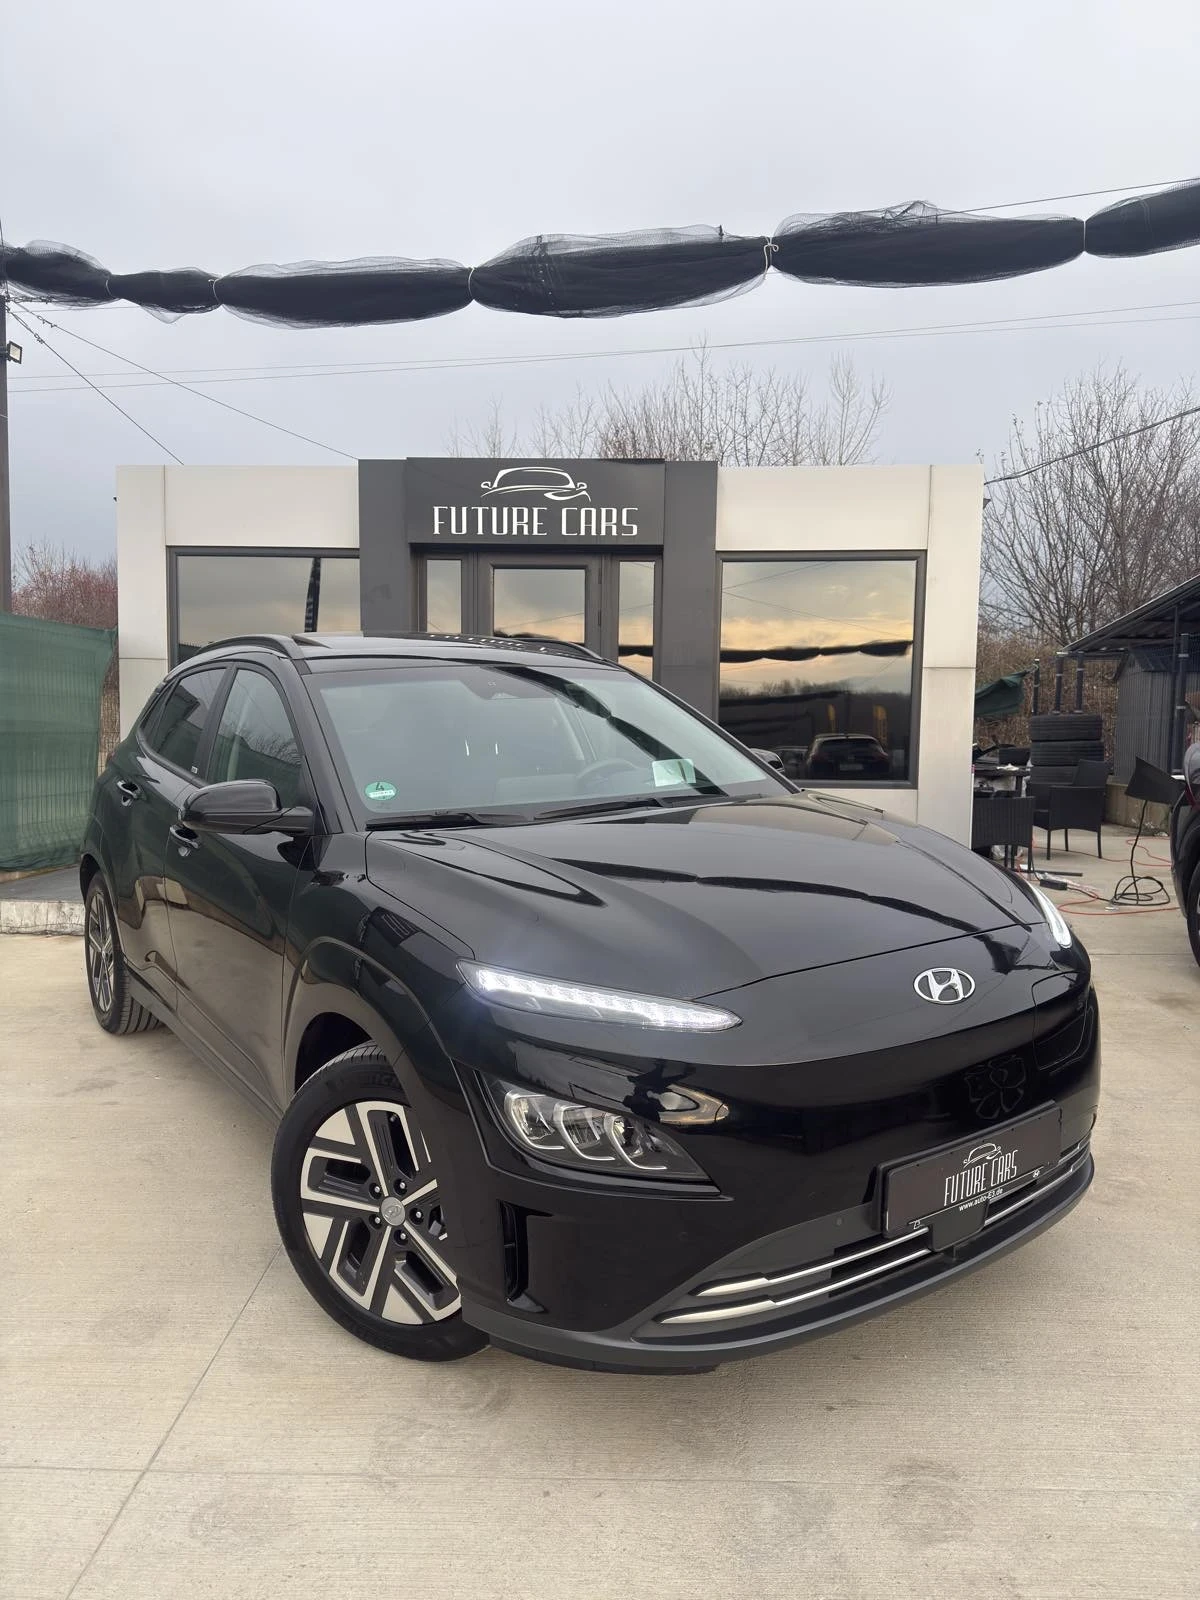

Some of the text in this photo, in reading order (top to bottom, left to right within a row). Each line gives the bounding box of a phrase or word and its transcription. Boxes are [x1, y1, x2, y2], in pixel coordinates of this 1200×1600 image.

[433, 506, 638, 536] FUTURE CARS
[944, 1150, 1018, 1206] FUTURE CARS
